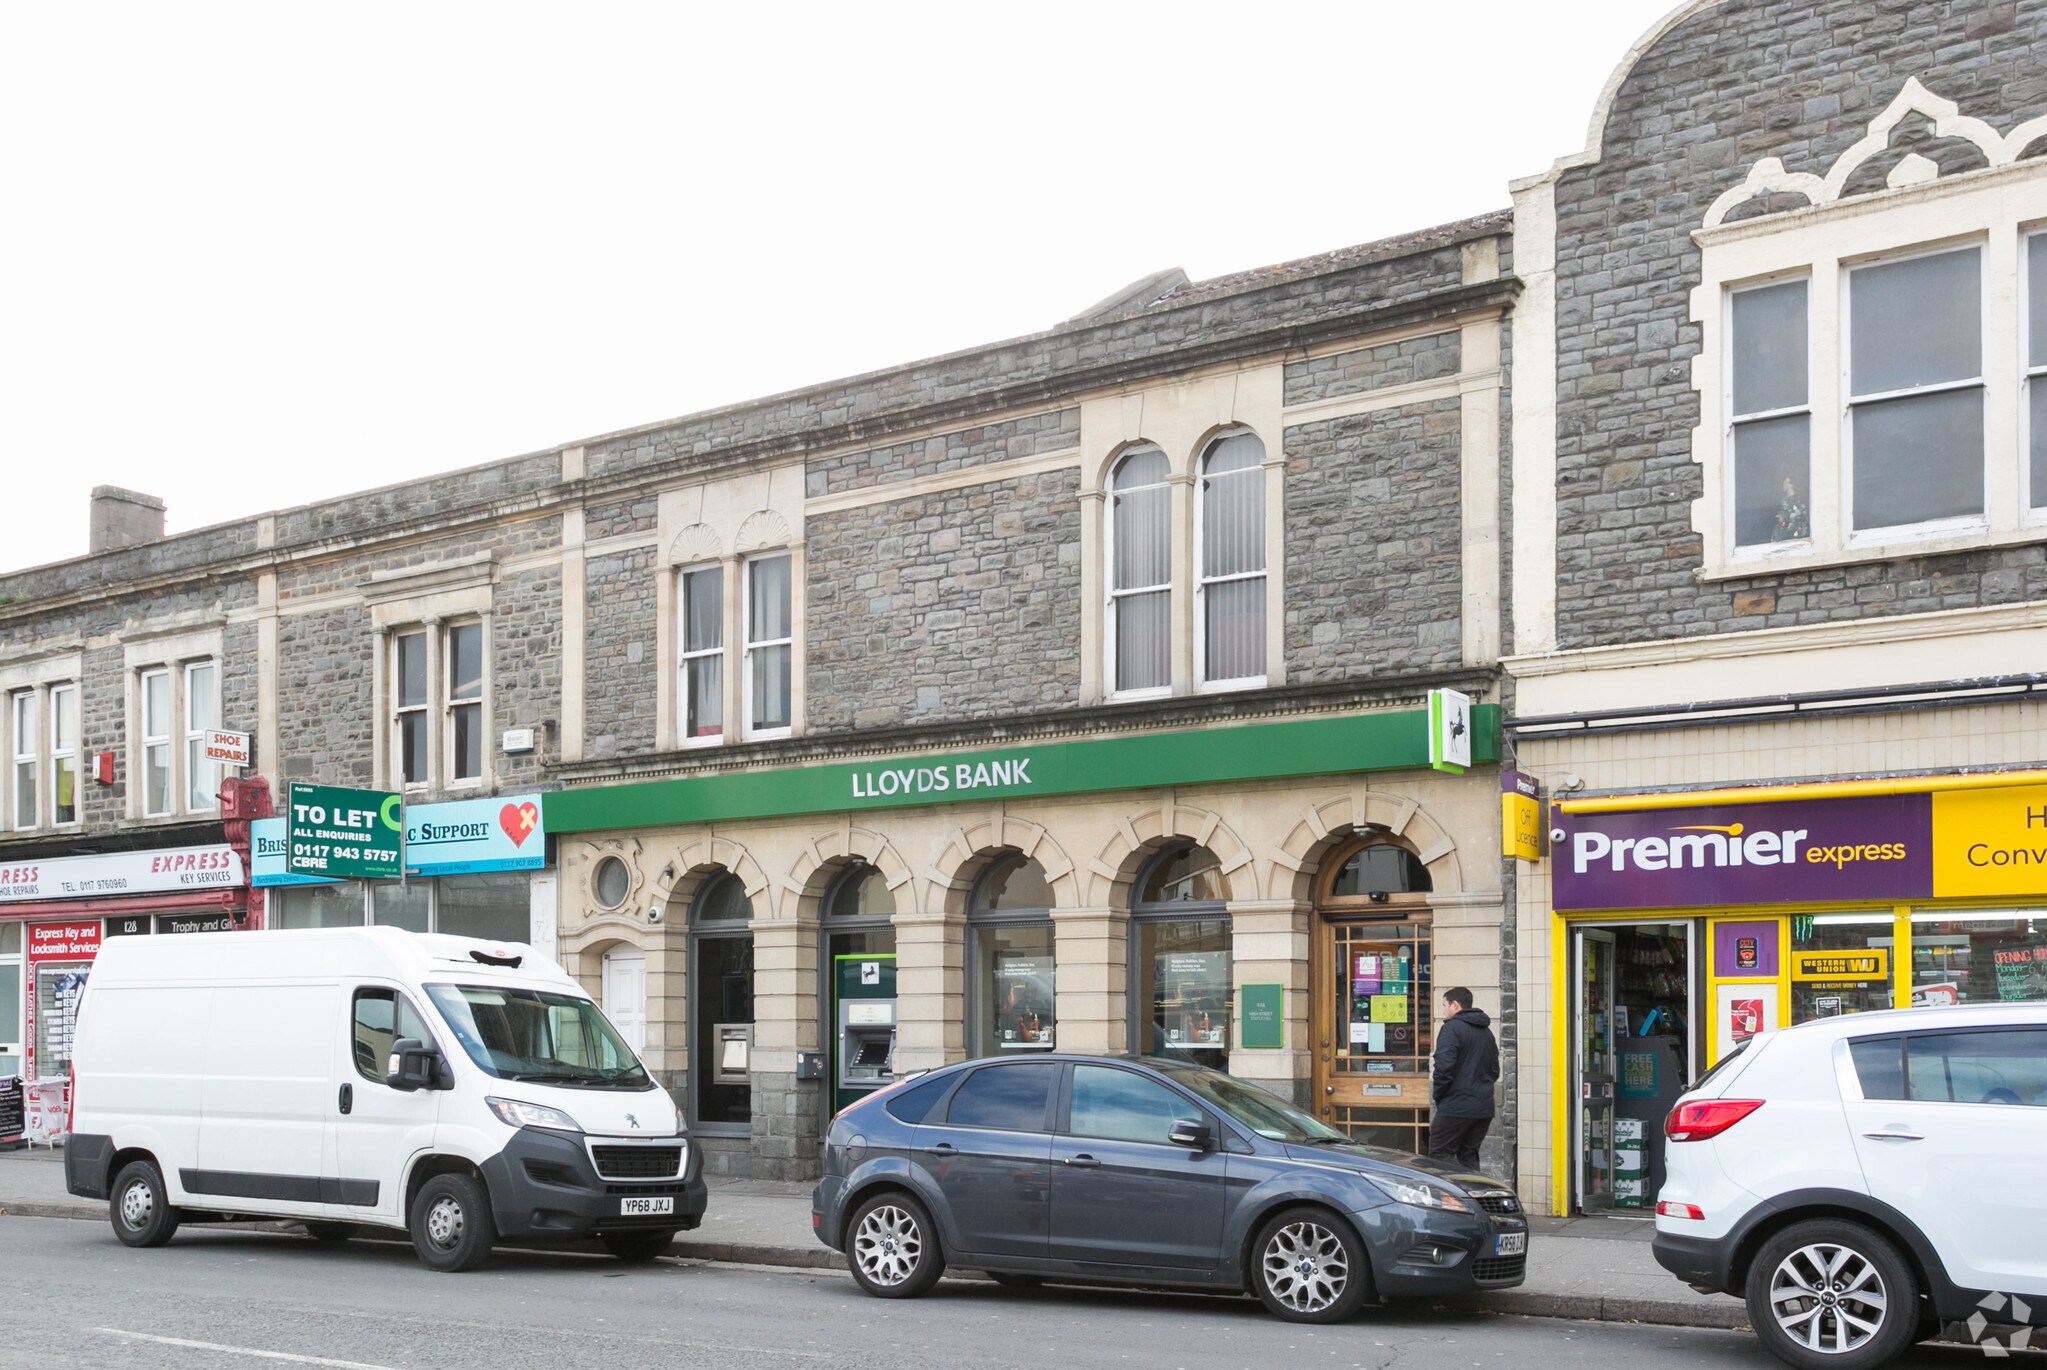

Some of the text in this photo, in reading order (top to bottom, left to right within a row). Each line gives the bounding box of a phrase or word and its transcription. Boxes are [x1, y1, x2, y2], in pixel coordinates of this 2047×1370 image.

[214, 734, 240, 746] SHOE
[207, 747, 247, 761] REPAIRS
[852, 758, 1032, 798] LLOYDS BANK
[294, 805, 377, 828] TO LET
[1520, 808, 1531, 827] Off
[293, 828, 372, 842] ALL ENQUIRIES
[1515, 825, 1538, 848] Licence
[294, 844, 398, 862] 0117 943 5757
[1573, 823, 1907, 874] Premier express
[151, 851, 230, 873] EXPRESS
[292, 857, 328, 869] CBRE
[440, 863, 453, 872] Local
[454, 863, 472, 872] People
[516, 859, 526, 868] 907
[180, 871, 231, 884] KEY SERVICES
[13, 884, 39, 896] REPAIRS
[61, 878, 128, 893] TEL: 0117 9760960
[124, 921, 137, 933] 128
[172, 921, 200, 933] Trophy
[202, 920, 218, 931] and
[35, 926, 96, 941] Express Key and
[31, 942, 99, 954] Locksmith Services
[1994, 949, 2031, 964] OPENING
[1849, 959, 1876, 972] WU
[1624, 1054, 1653, 1064] FREE
[1624, 1063, 1653, 1072] CASH
[1624, 1076, 1653, 1086] HERE
[626, 1199, 670, 1213] YP68 JXJ
[1822, 1294, 1835, 1303] KIA
